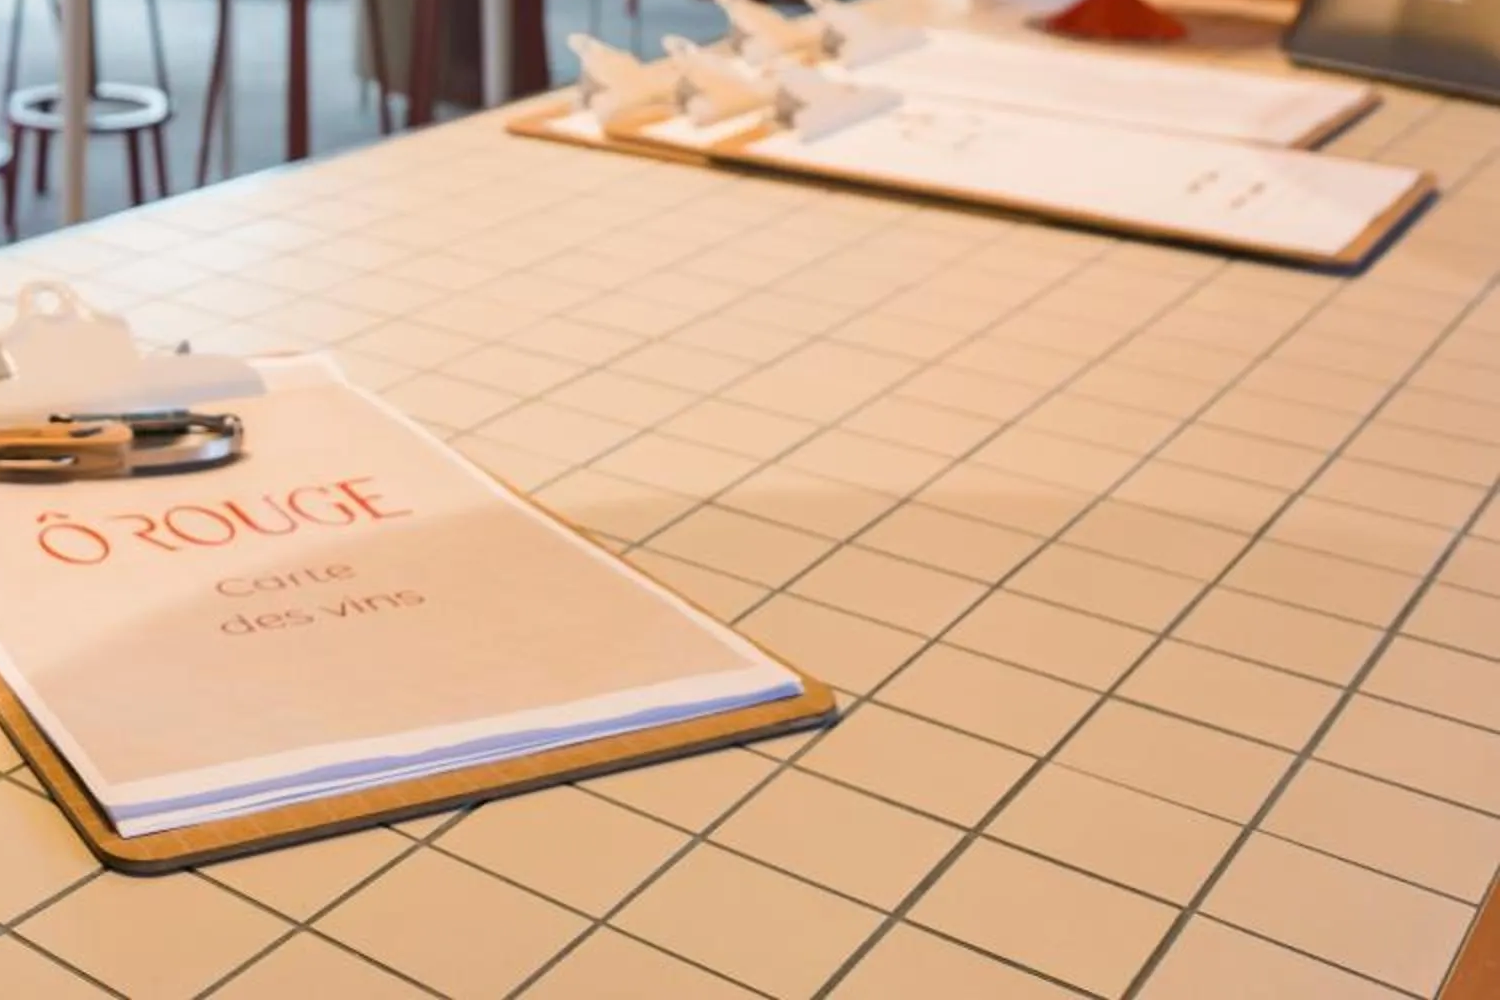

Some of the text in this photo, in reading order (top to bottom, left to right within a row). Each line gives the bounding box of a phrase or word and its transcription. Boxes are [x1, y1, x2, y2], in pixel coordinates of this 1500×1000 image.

[36, 475, 414, 566] Ô ROUGE
[219, 587, 427, 637] des vins
